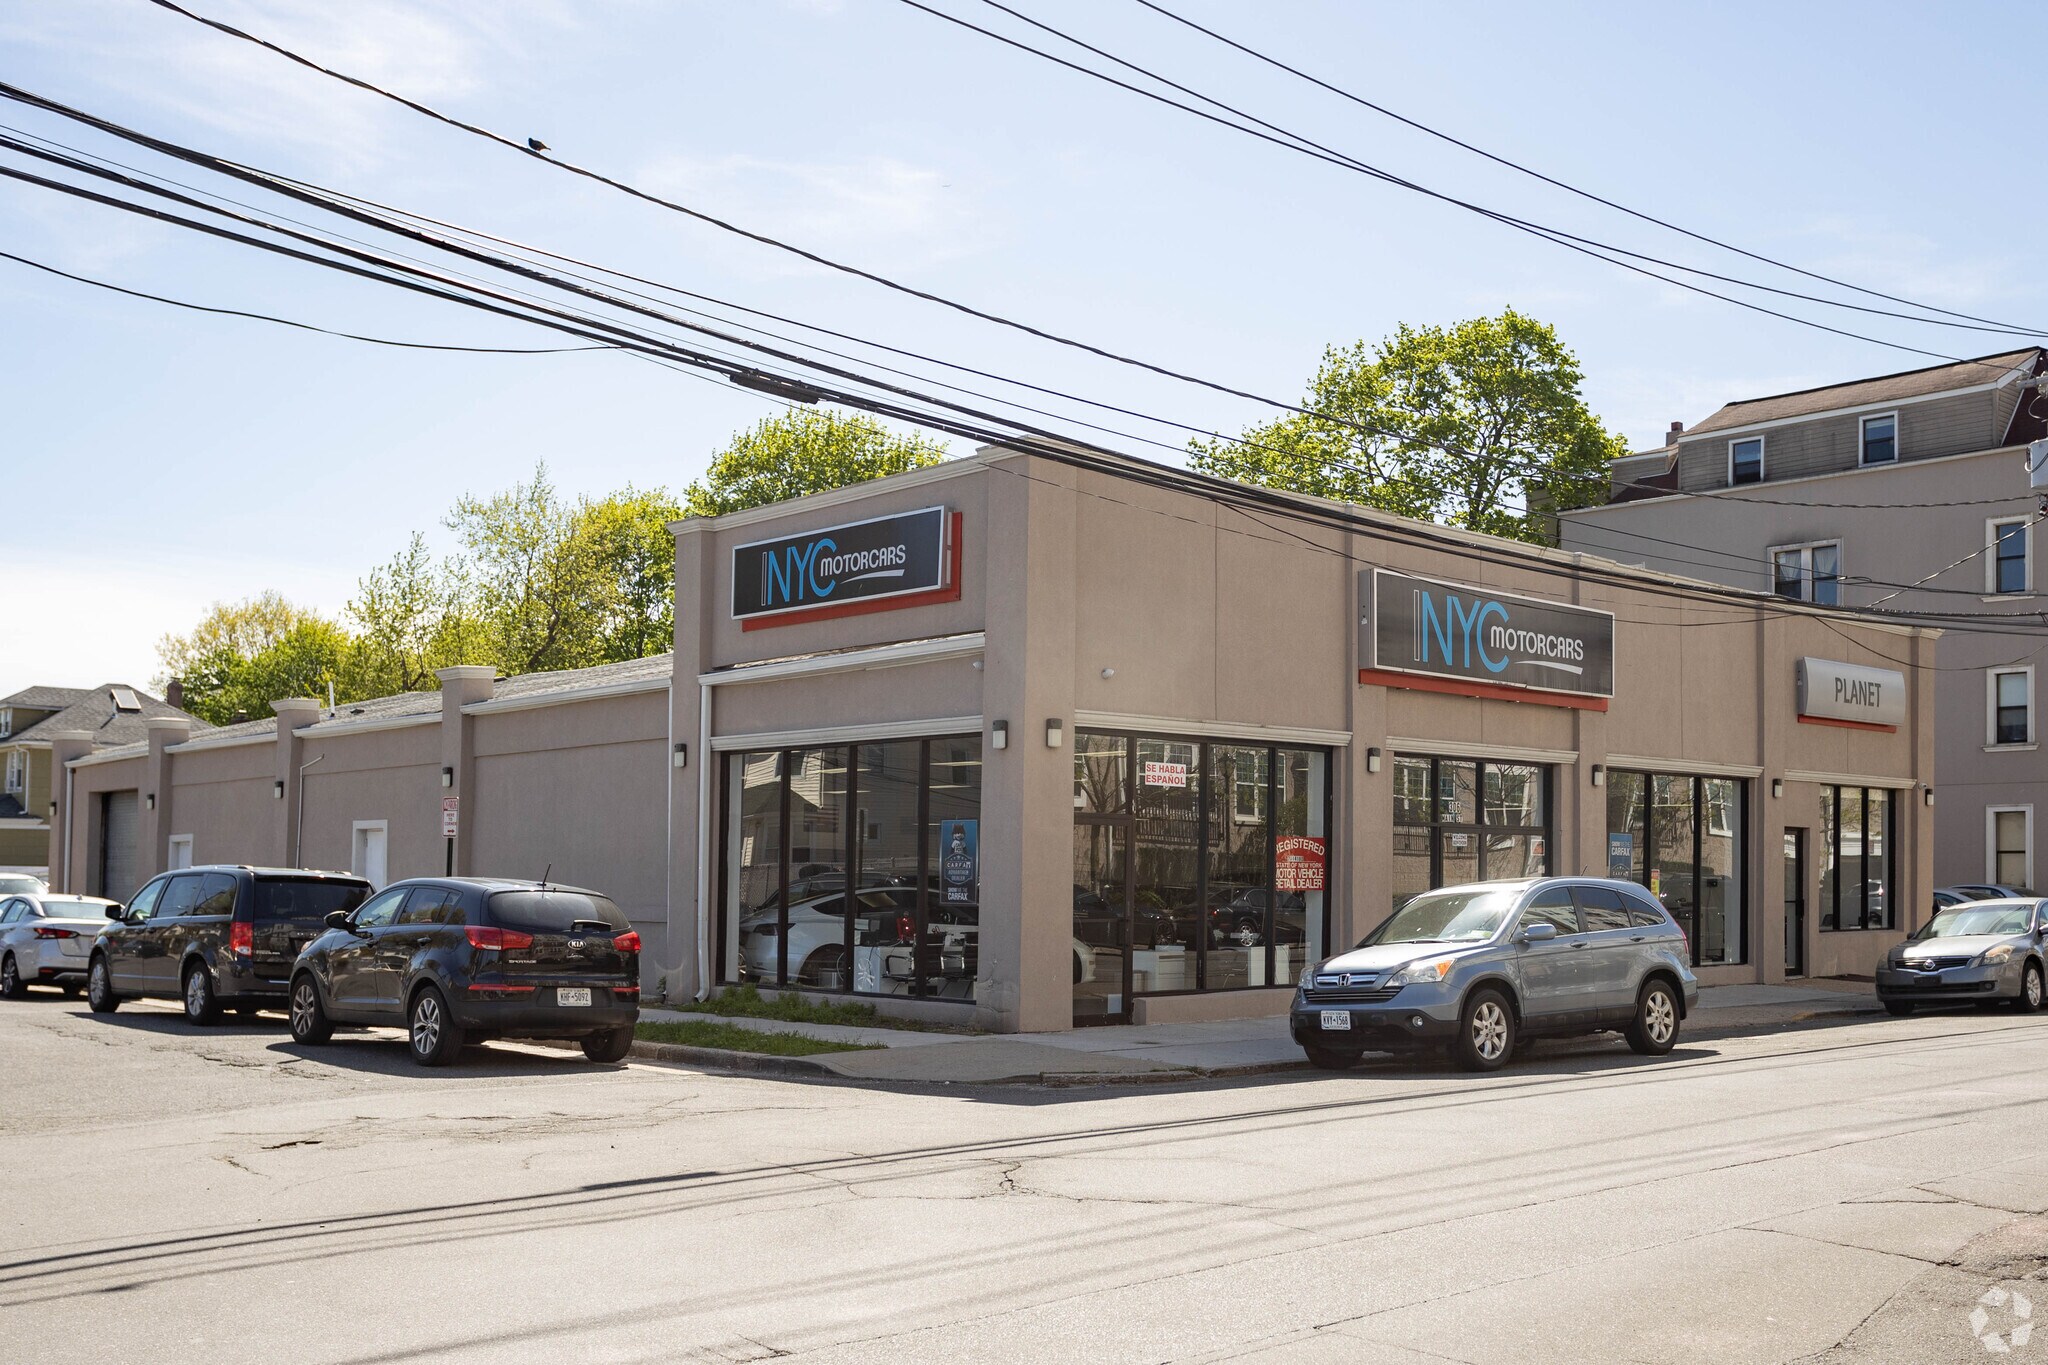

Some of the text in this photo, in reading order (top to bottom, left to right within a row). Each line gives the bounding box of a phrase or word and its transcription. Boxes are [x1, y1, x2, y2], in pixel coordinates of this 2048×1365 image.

[767, 538, 906, 605] NYC MOTORCARS
[1422, 591, 1583, 672] NYC MOTORCARS
[1835, 677, 1881, 708] PLANET
[1146, 764, 1185, 774] SE HABLA
[1146, 774, 1185, 785] ESPAÑOL
[1611, 847, 1631, 857] CARFAX
[1297, 868, 1324, 879] VEHICLE
[1297, 878, 1323, 889] DEALER
[947, 892, 968, 901] CARFAX
[571, 940, 584, 948] KIA
